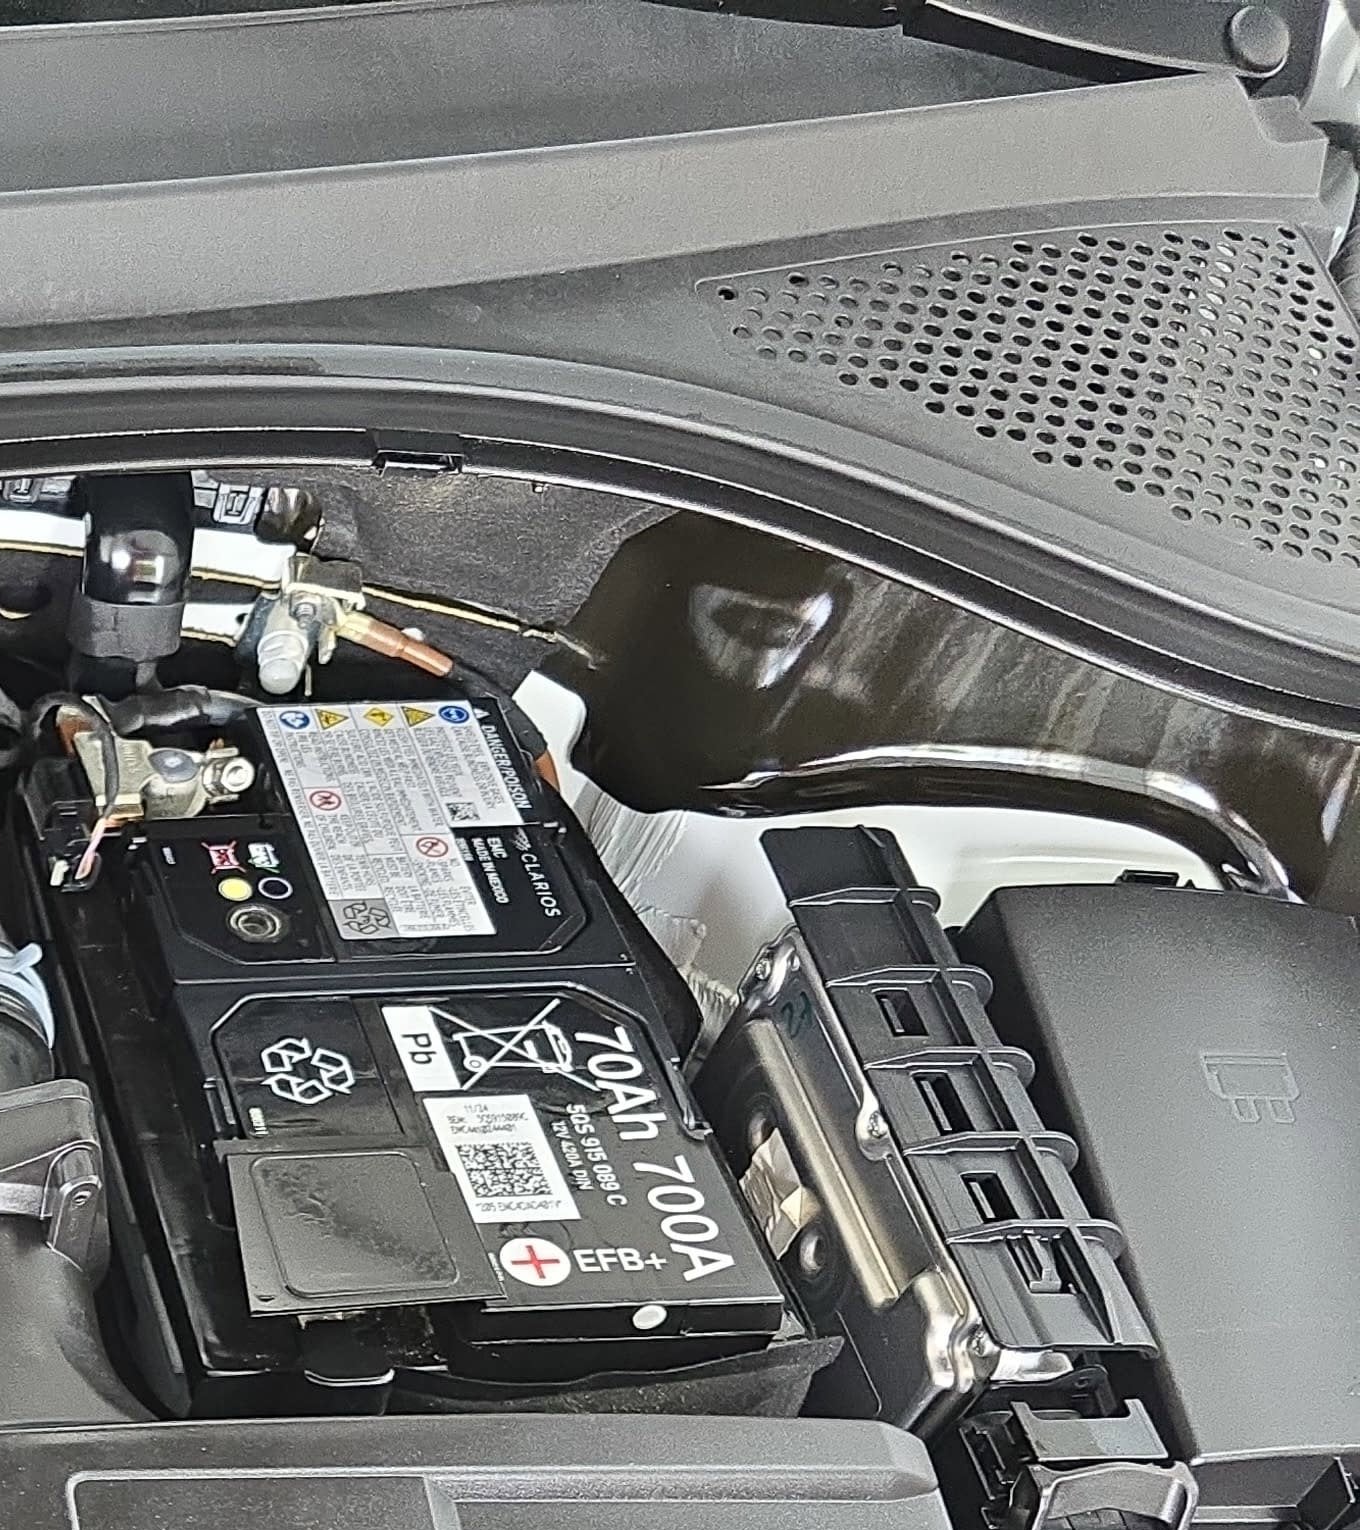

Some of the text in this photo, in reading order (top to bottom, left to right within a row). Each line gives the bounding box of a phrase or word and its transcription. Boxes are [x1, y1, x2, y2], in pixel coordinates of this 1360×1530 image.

[481, 725, 532, 809] DANGER/POISON
[487, 837, 508, 859] EMC
[472, 838, 489, 863] MADE
[486, 871, 509, 904] MEXICO
[521, 853, 561, 917] CLARIOS
[400, 1032, 437, 1065] Pb
[551, 1120, 595, 1191] 12V 420A DIN
[575, 1026, 736, 1282] 70Ah 700A
[580, 1134, 608, 1162] 915
[592, 1163, 620, 1192] 089
[606, 1194, 628, 1207] C
[573, 1247, 669, 1273] EFB+
